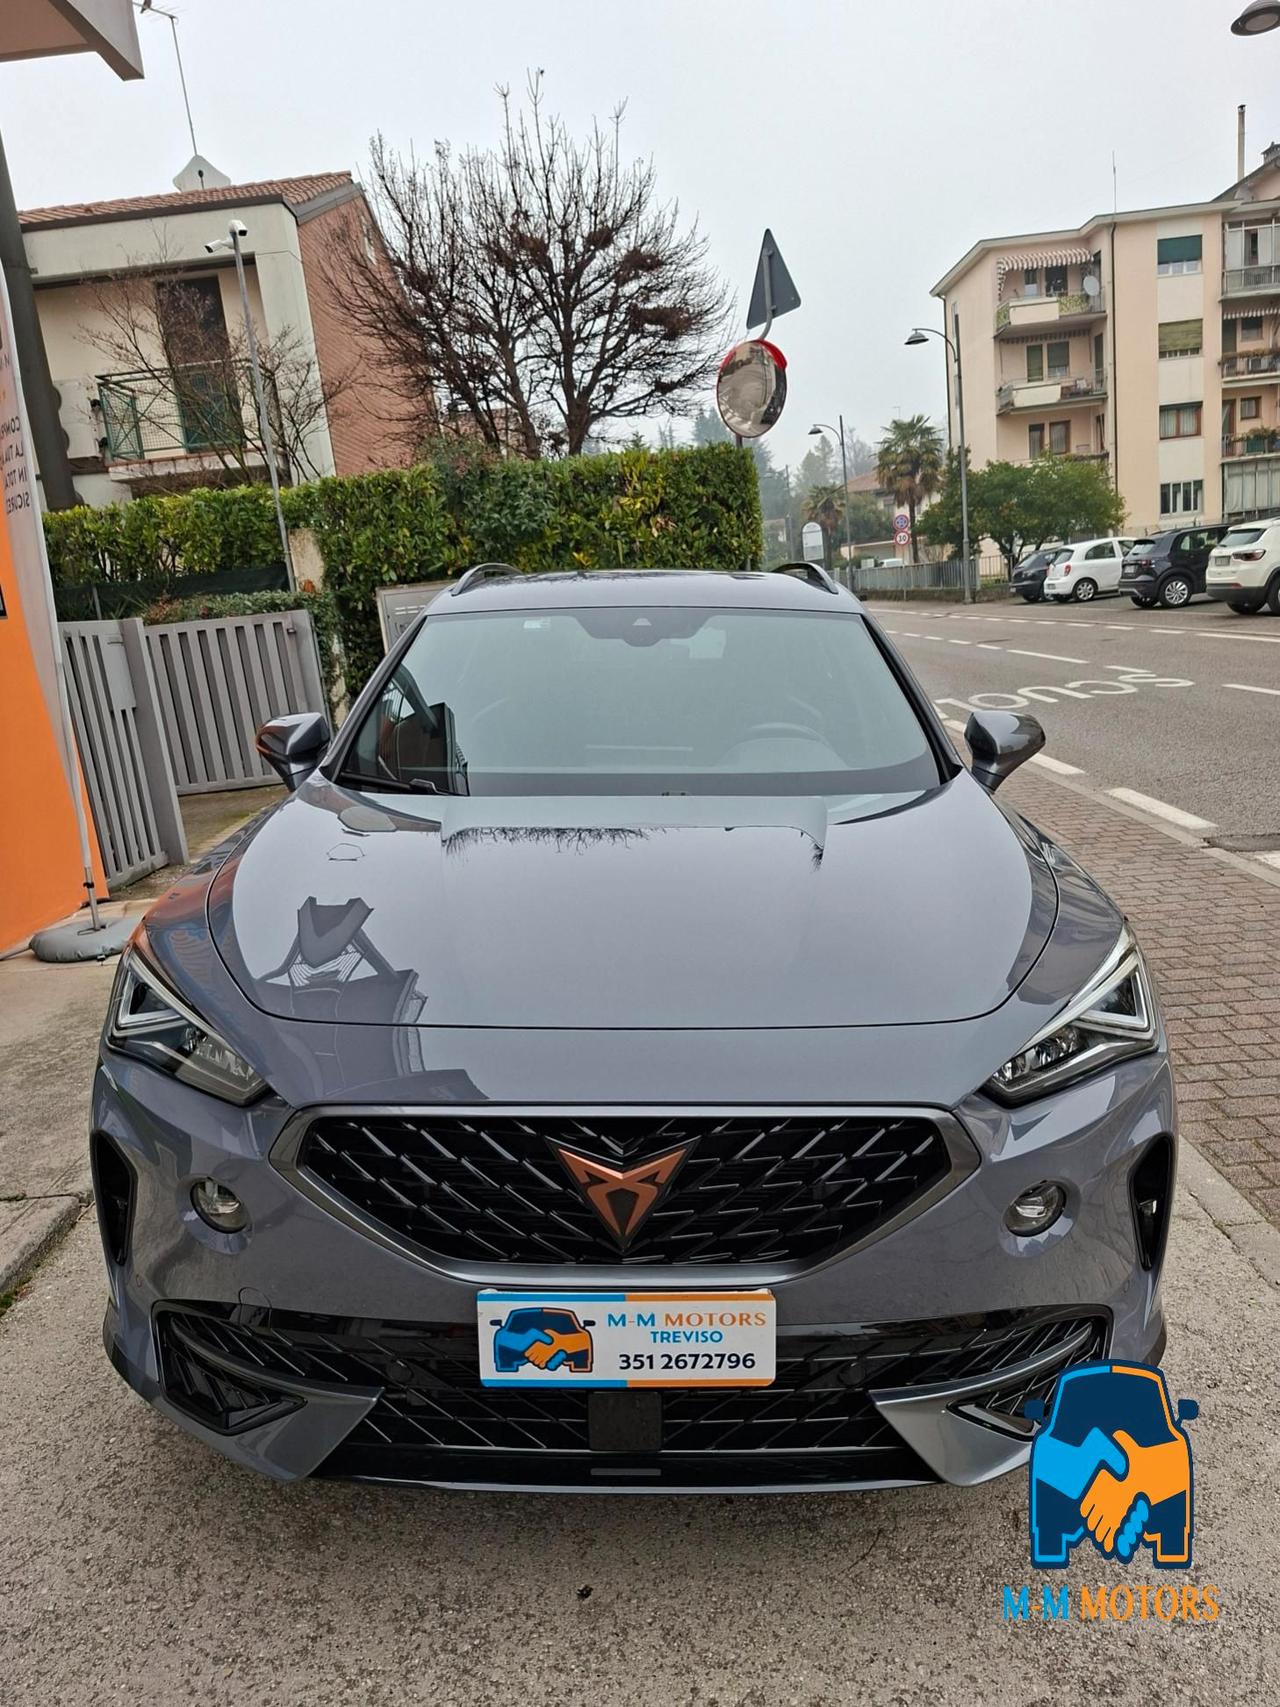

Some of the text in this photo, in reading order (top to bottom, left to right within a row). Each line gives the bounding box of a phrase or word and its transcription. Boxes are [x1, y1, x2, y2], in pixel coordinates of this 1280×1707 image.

[931, 673, 1195, 719] SCUOL
[607, 1312, 767, 1327] M-M MOTORS
[650, 1330, 723, 1343] TREVISO
[618, 1352, 756, 1370] 351 2672796
